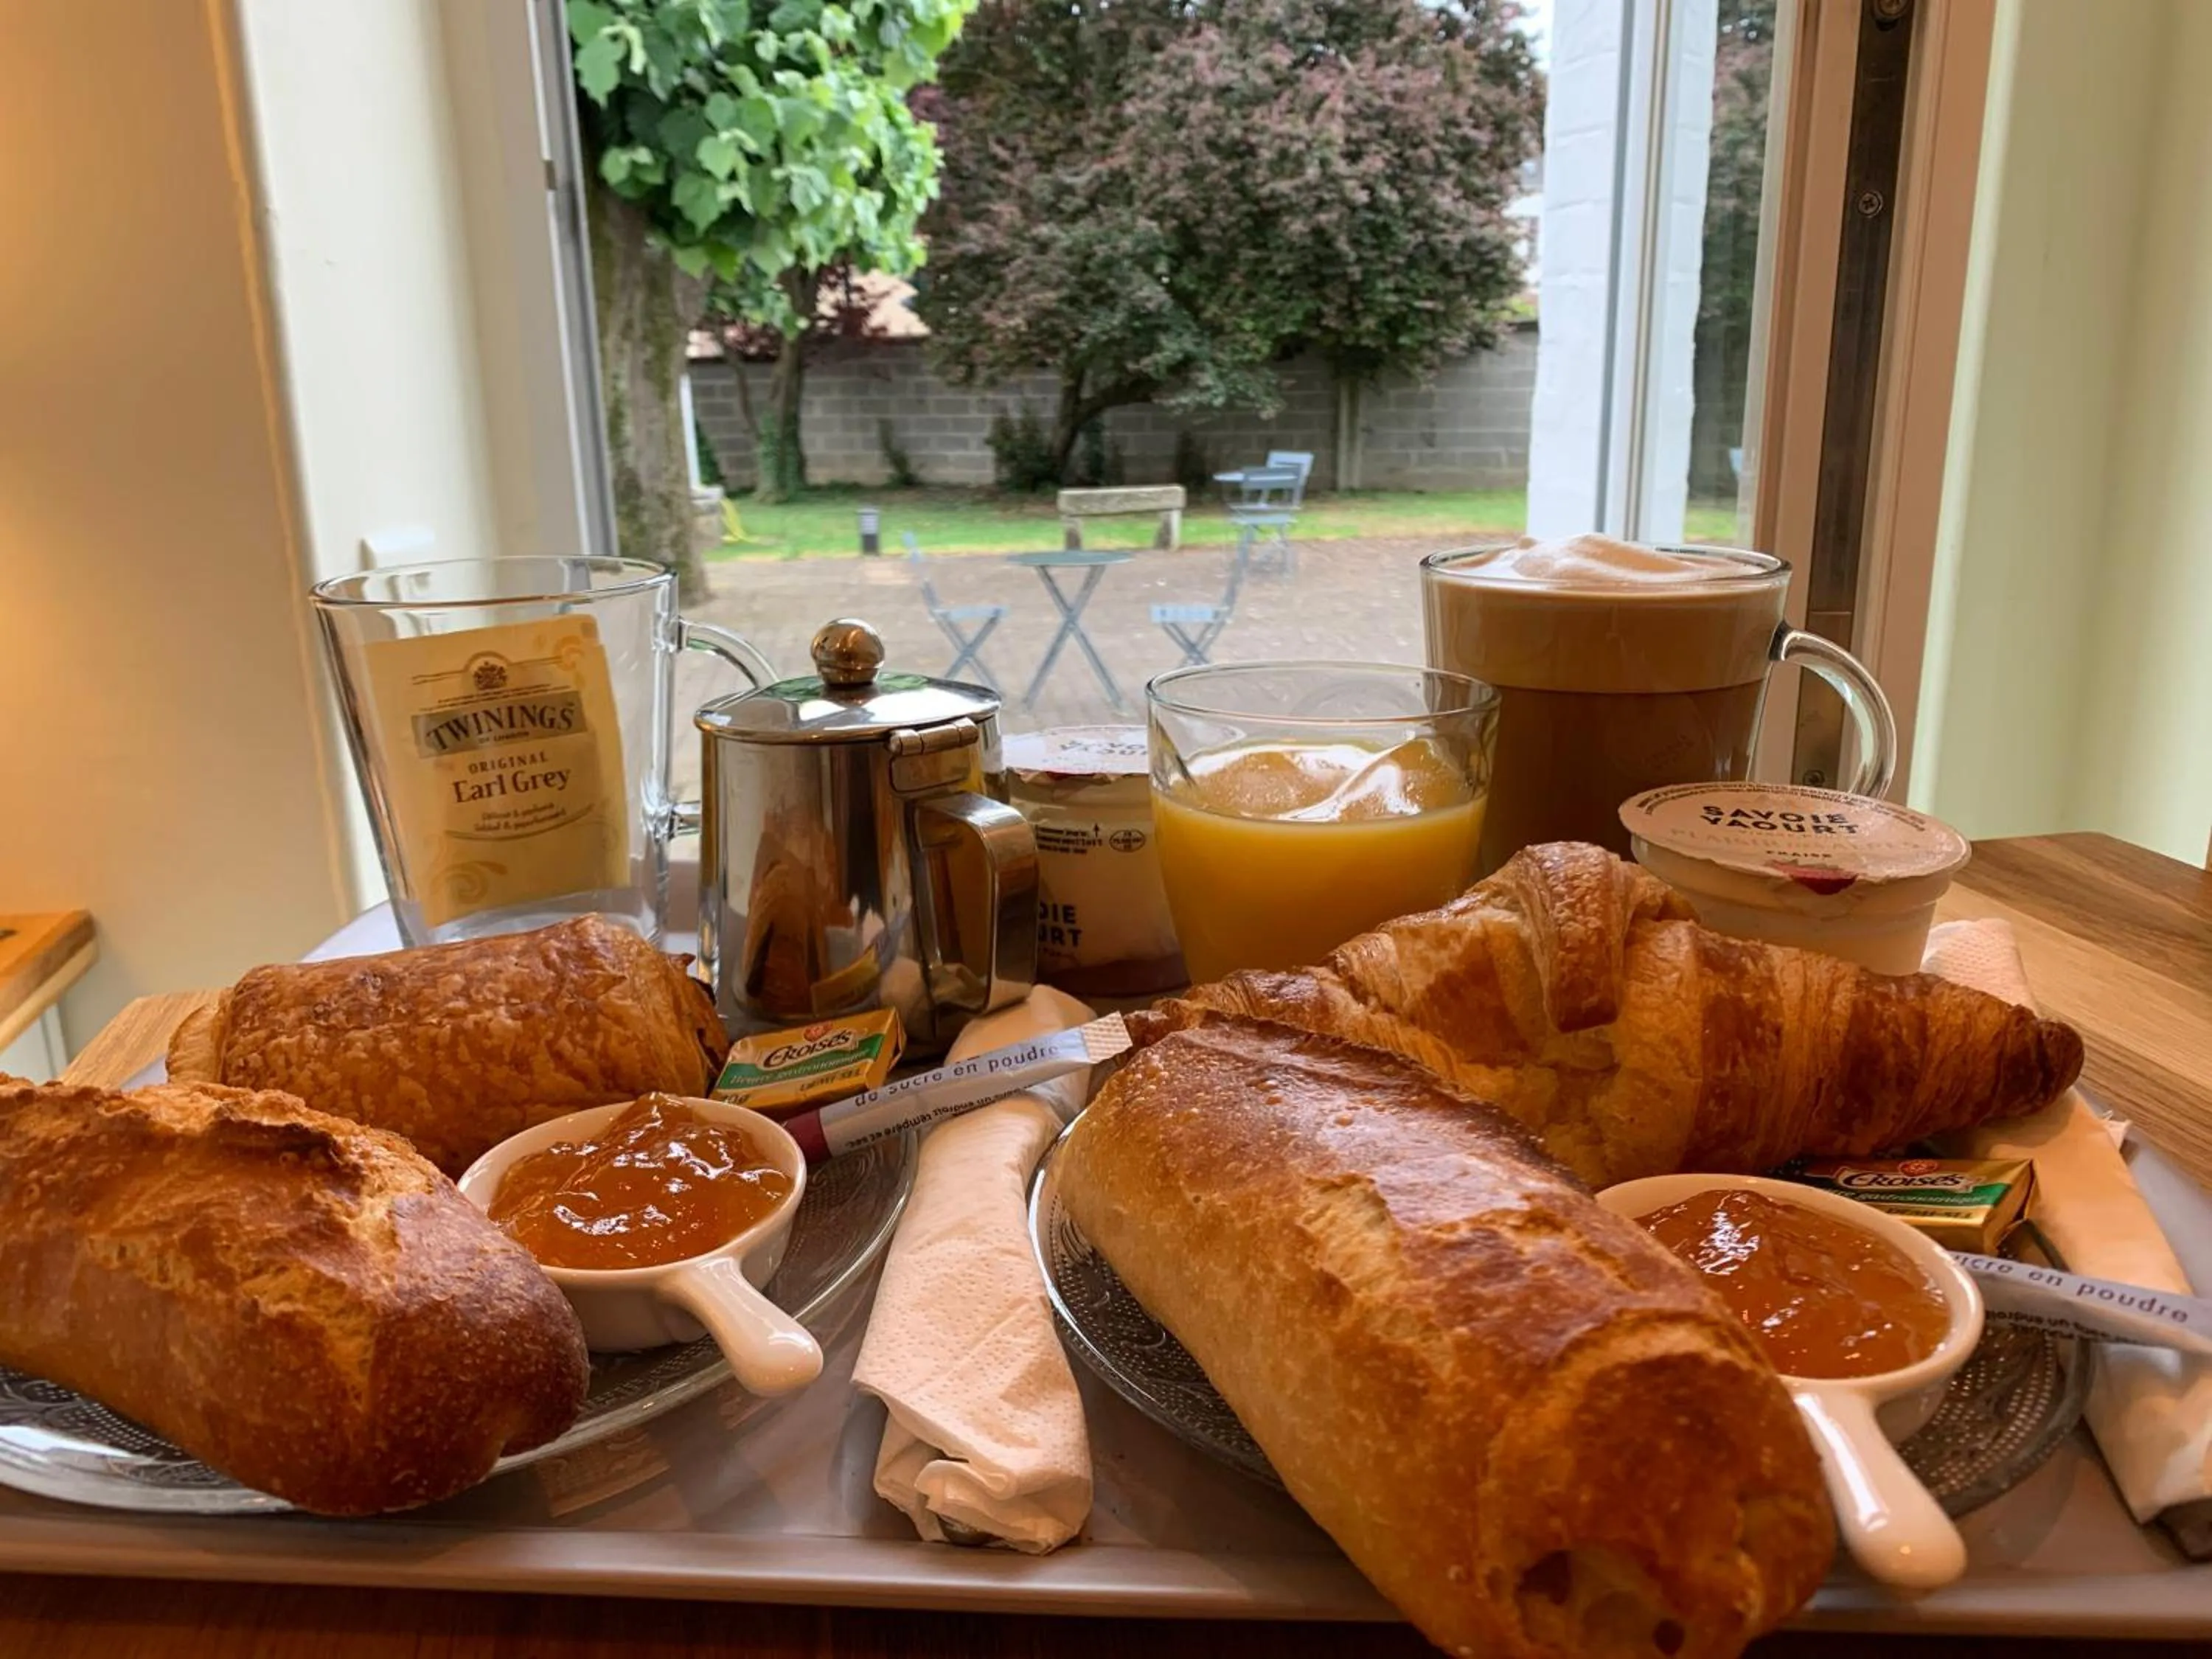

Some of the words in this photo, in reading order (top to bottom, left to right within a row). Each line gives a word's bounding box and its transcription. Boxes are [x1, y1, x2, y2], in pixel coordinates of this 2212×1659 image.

[426, 704, 576, 750] TWININGS
[468, 751, 549, 775] ORIGINAL
[452, 773, 508, 803] Earl
[512, 768, 571, 793] Grey
[1700, 814, 1859, 834] YAOURT
[1703, 805, 1848, 824] SAVOIE
[855, 1091, 879, 1108] de
[888, 1072, 943, 1096] sucre
[953, 1061, 978, 1077] en
[988, 1044, 1060, 1074] poudre
[1955, 1255, 2014, 1273] ucre
[2028, 1270, 2063, 1287] en
[2076, 1282, 2190, 1324] poudre
